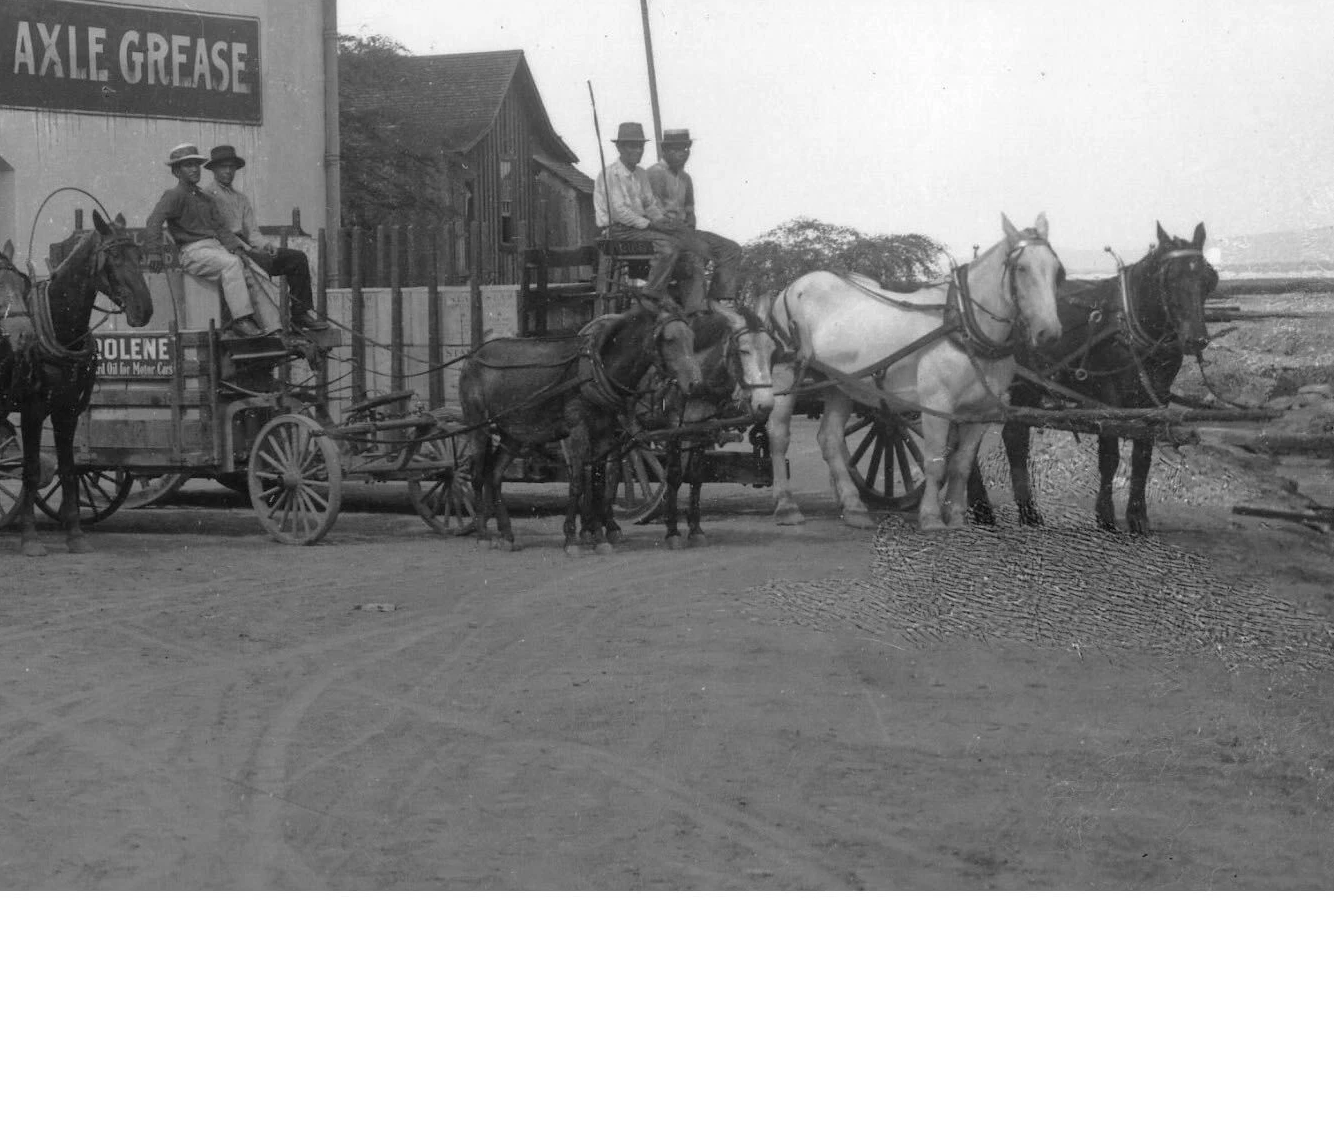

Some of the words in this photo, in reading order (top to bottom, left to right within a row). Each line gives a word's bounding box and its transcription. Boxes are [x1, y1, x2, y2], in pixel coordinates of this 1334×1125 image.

[12, 21, 109, 82] AXLE
[118, 30, 249, 95] GREASE
[107, 361, 118, 375] Oil
[119, 361, 131, 375] for
[132, 361, 156, 375] Motor
[157, 361, 174, 376] Cars
